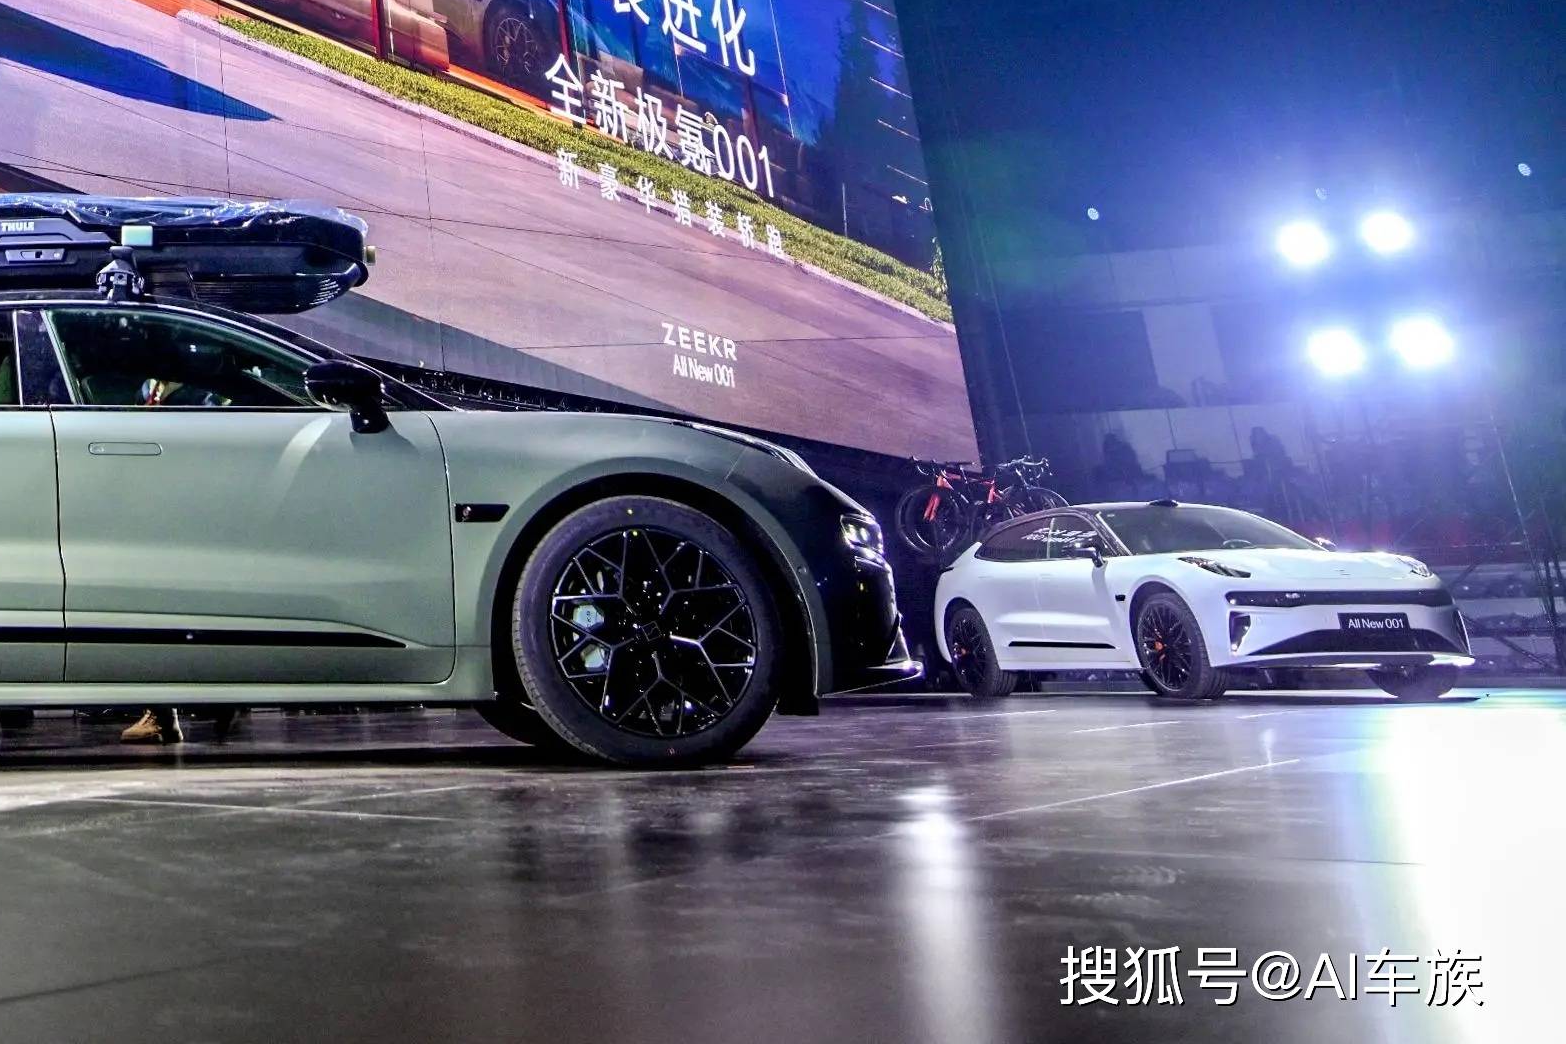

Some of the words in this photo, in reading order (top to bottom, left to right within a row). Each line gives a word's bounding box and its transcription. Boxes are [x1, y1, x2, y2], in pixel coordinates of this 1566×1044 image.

[545, 53, 775, 198] 全新极氪001
[1, 221, 35, 232] THULE
[661, 322, 738, 361] ZEEKR
[673, 354, 688, 377] All
[687, 357, 714, 383] New
[714, 363, 736, 389] 001
[1348, 618, 1361, 629] All
[1361, 618, 1384, 629] New
[1384, 618, 1404, 629] 001
